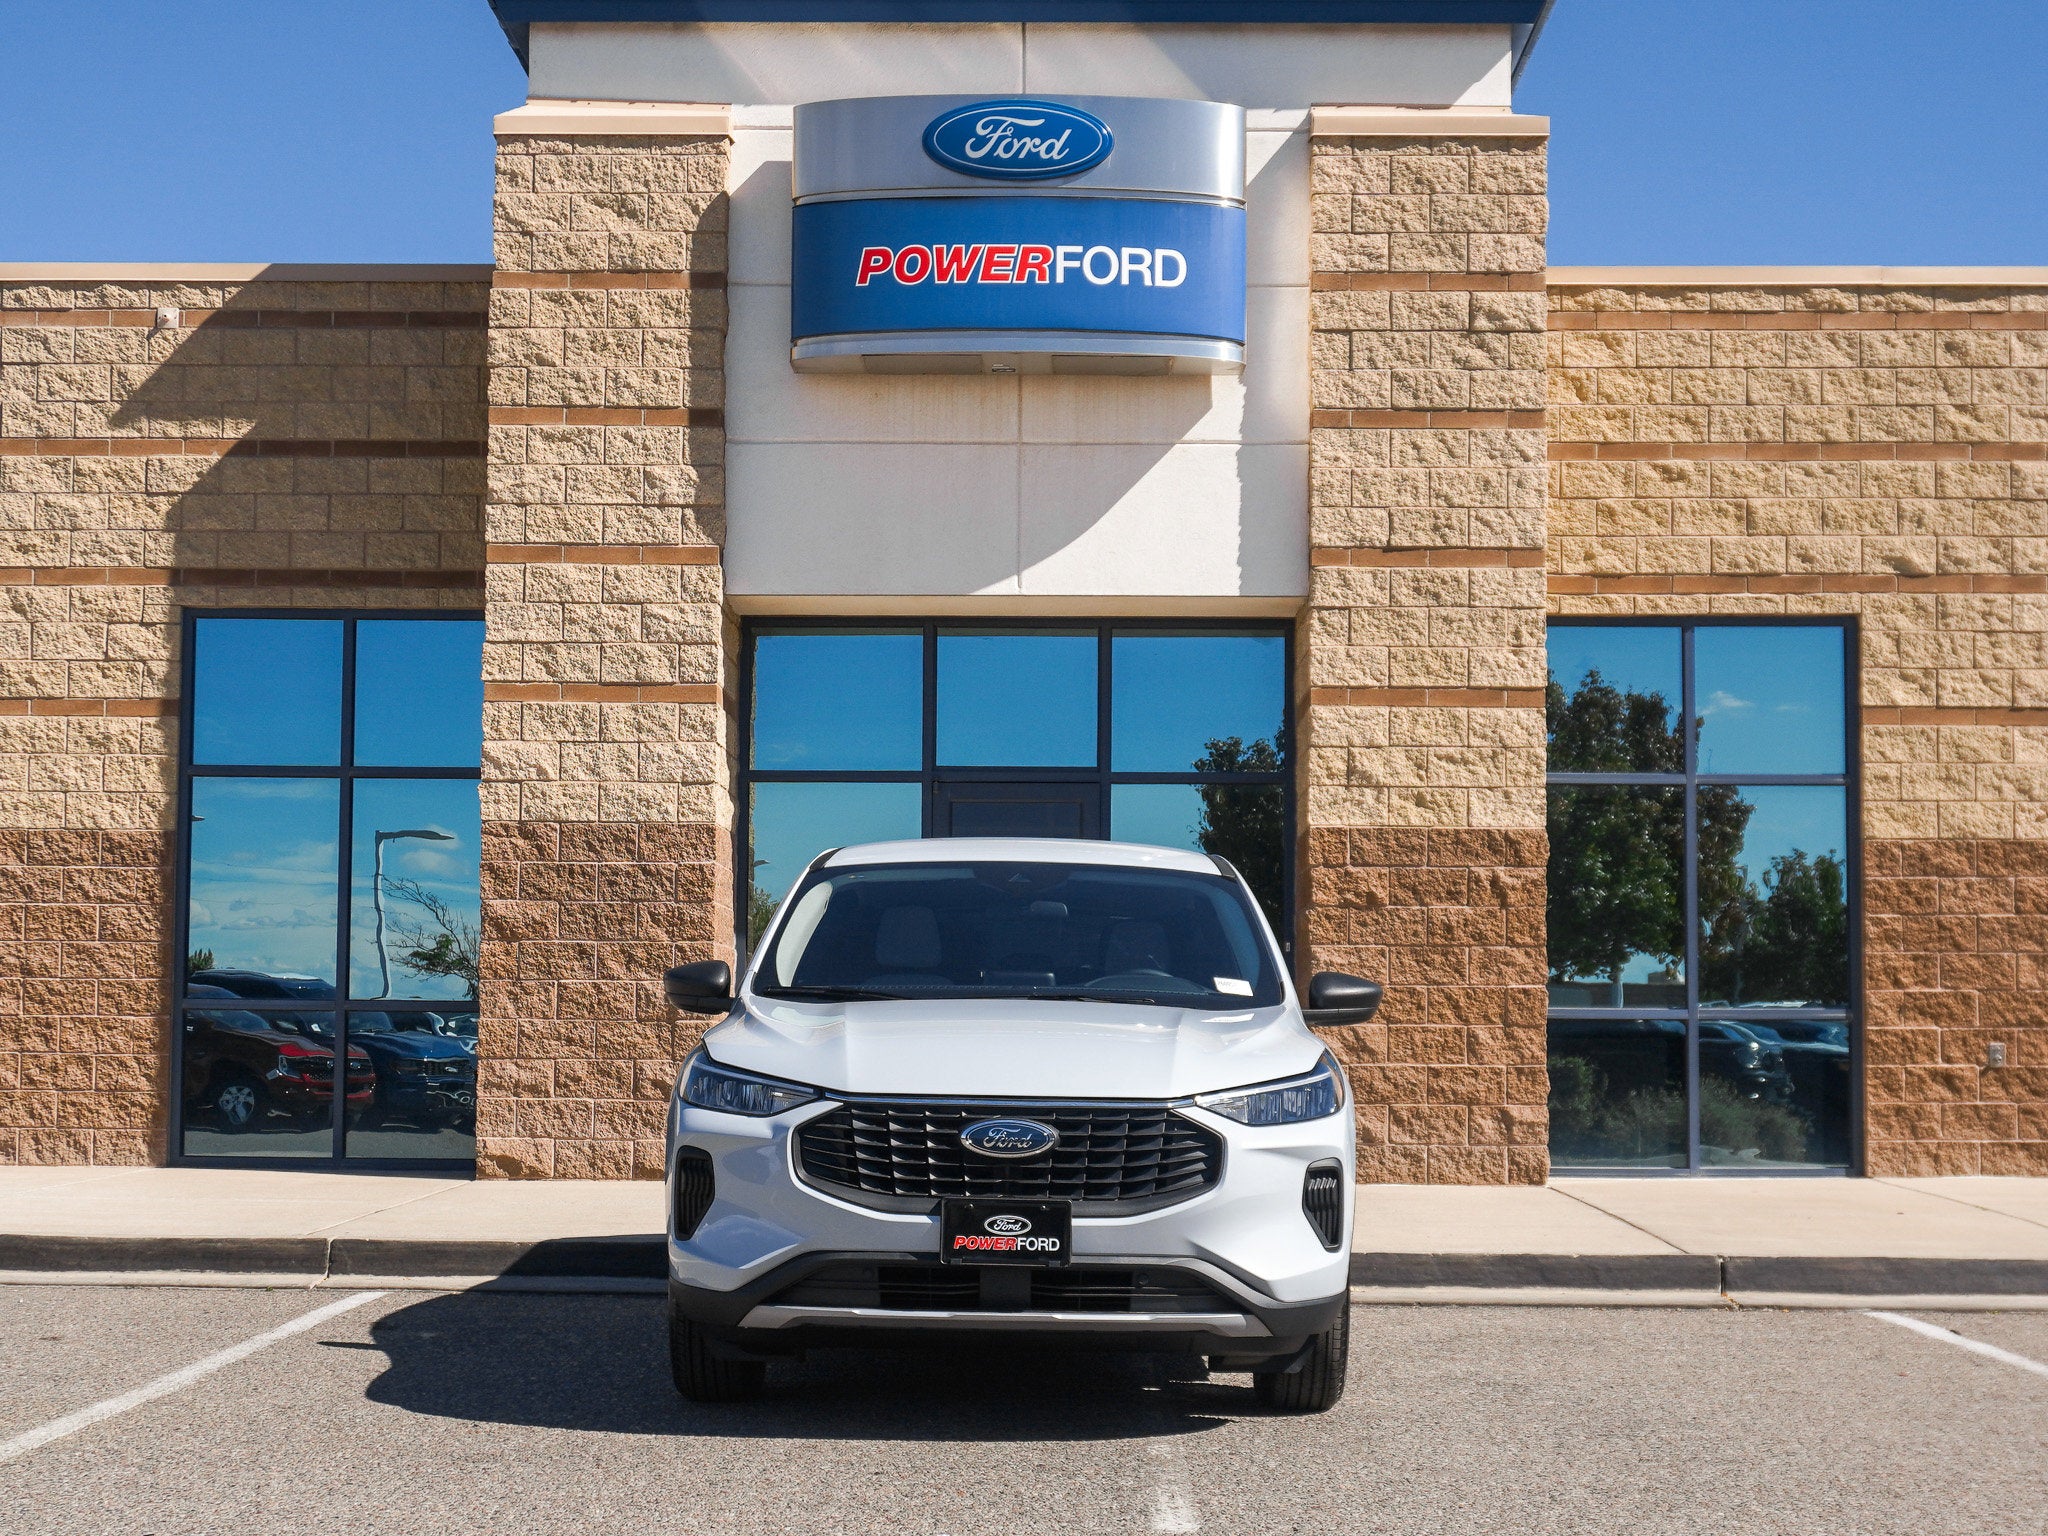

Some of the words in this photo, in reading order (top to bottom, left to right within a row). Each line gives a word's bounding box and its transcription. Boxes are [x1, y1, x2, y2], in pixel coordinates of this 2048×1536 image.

[965, 116, 1072, 160] Ford
[983, 1127, 1033, 1148] Ford
[993, 1218, 1022, 1231] Ford
